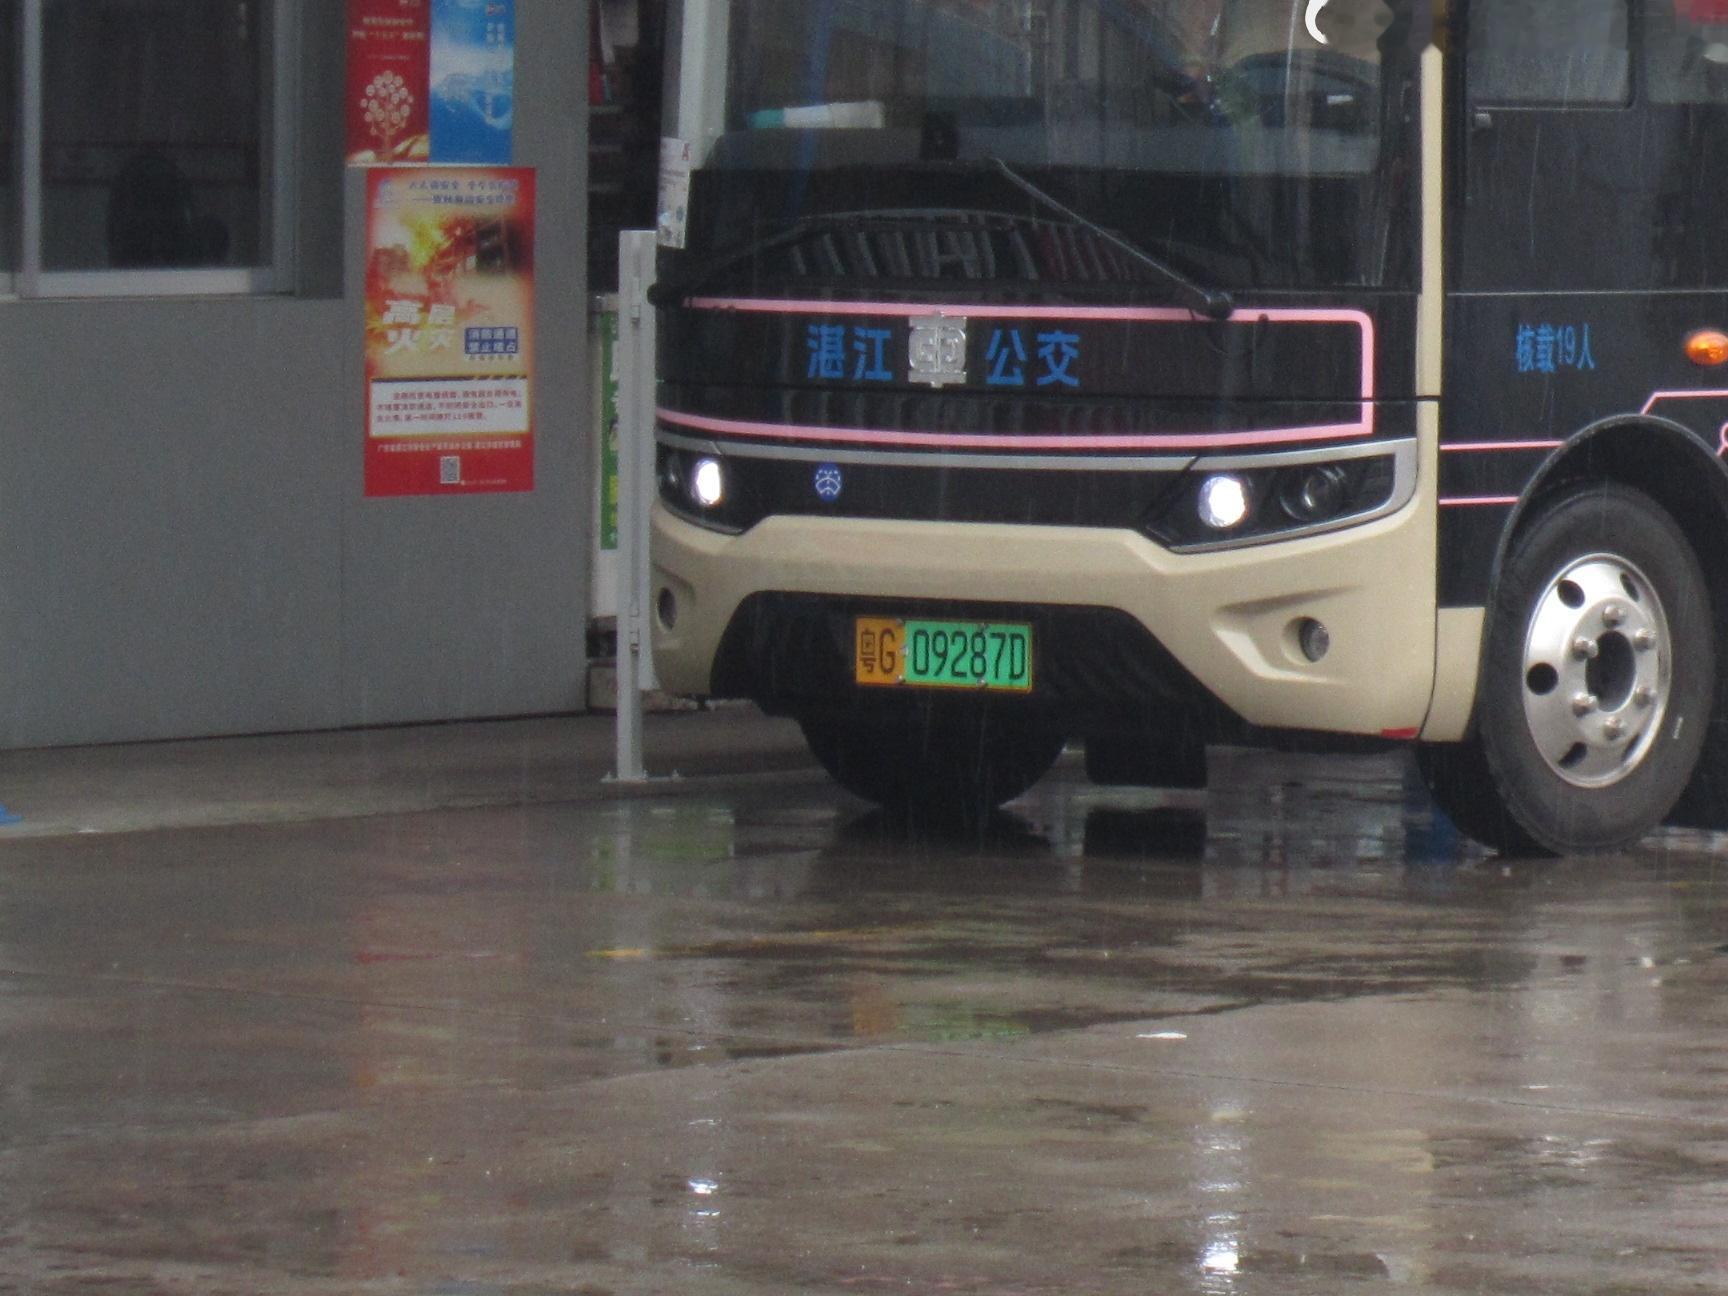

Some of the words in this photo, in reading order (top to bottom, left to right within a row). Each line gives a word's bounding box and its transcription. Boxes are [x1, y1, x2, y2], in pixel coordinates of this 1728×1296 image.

[807, 324, 892, 381] 湛江
[985, 329, 1080, 386] 公交
[1516, 322, 1595, 373] 核载19人
